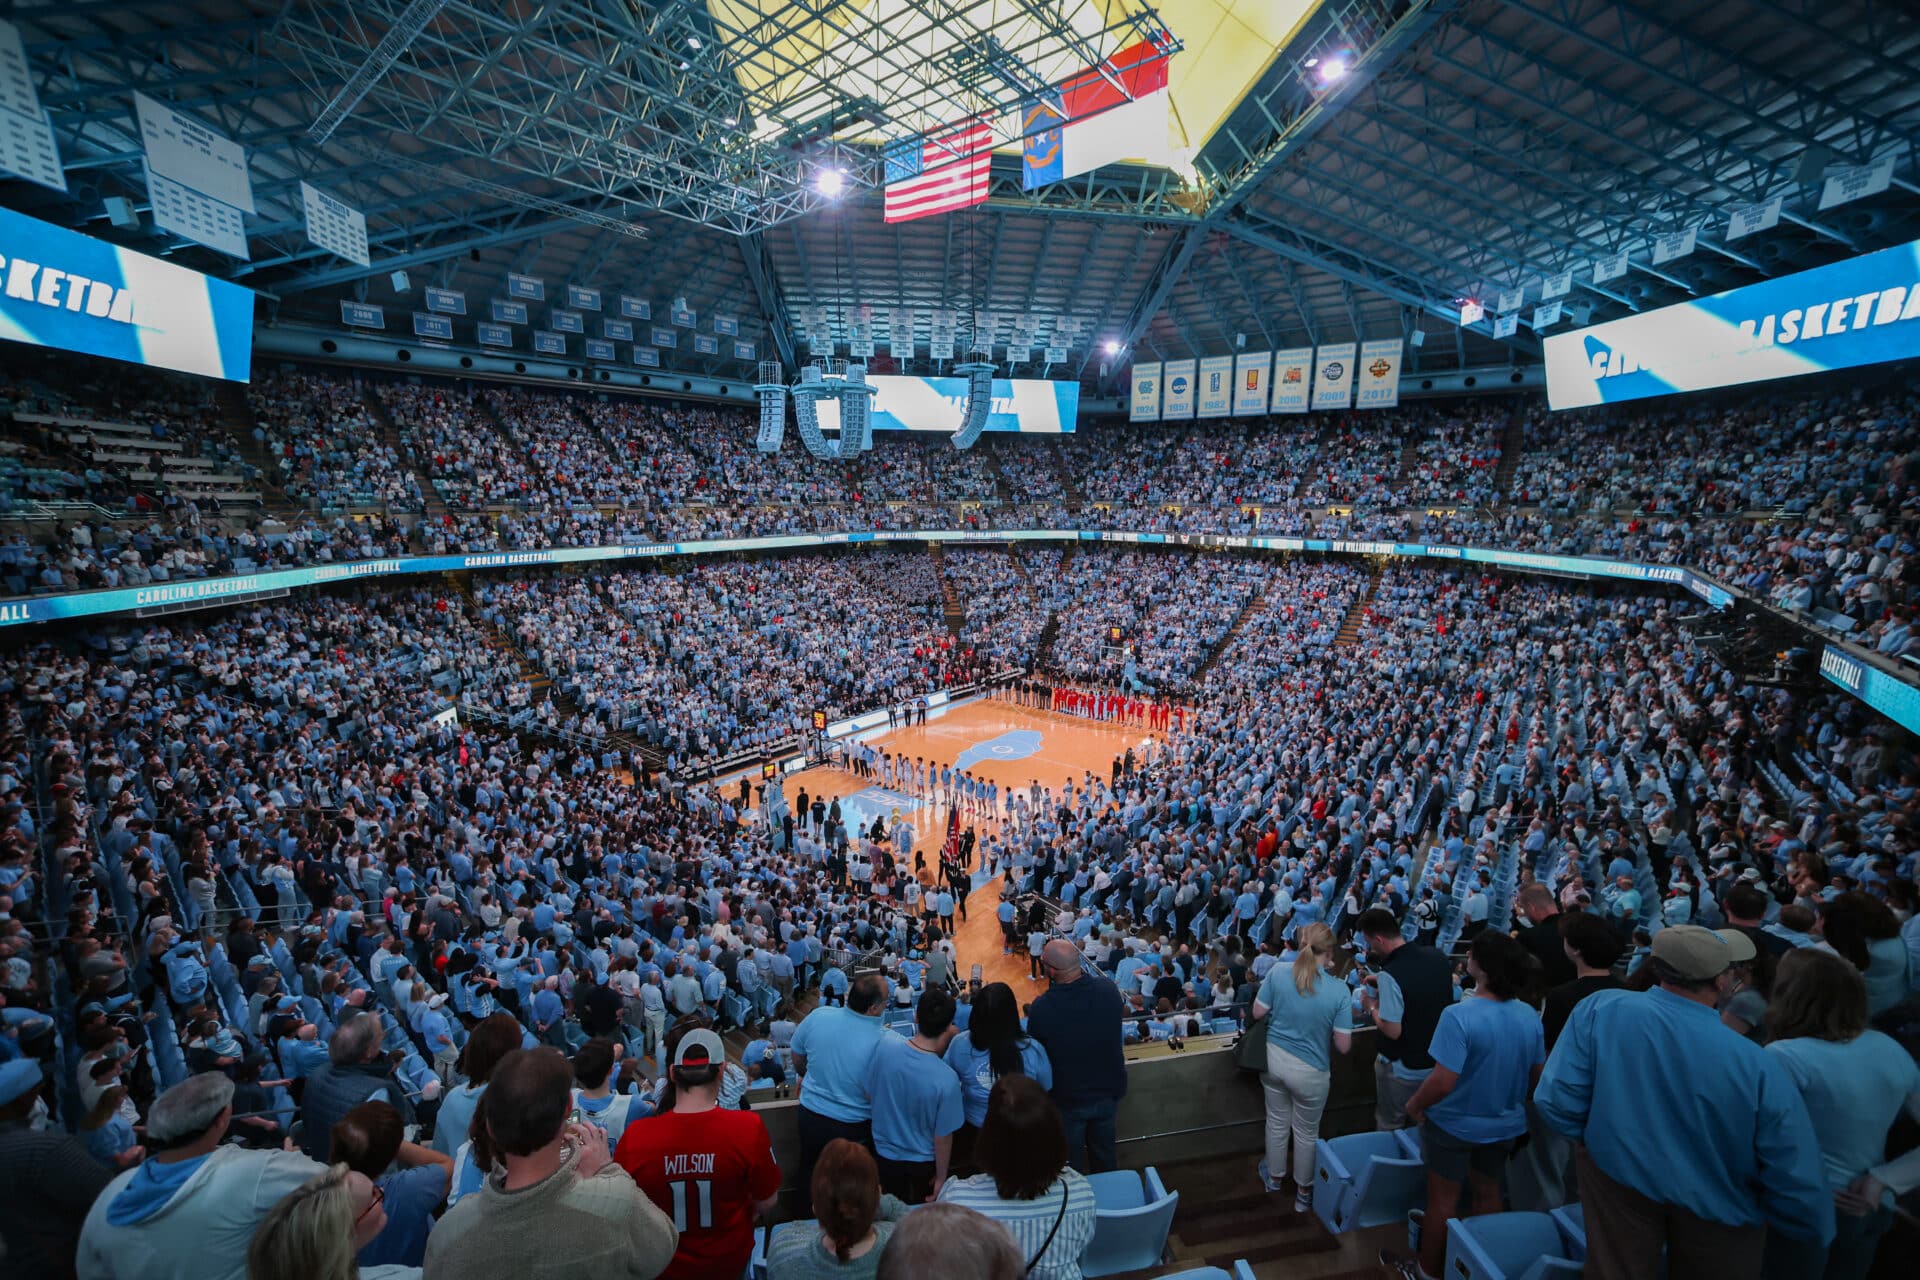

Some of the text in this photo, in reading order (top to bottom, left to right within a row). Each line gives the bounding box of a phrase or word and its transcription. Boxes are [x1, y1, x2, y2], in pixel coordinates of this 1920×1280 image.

[1363, 388, 1393, 400] 2017
[464, 554, 506, 567] CAROLINA
[136, 577, 258, 605] CAROLINA BASKETBALL
[0, 602, 30, 621] ALL
[664, 1153, 716, 1175] WILSON
[669, 1180, 713, 1233] 11
